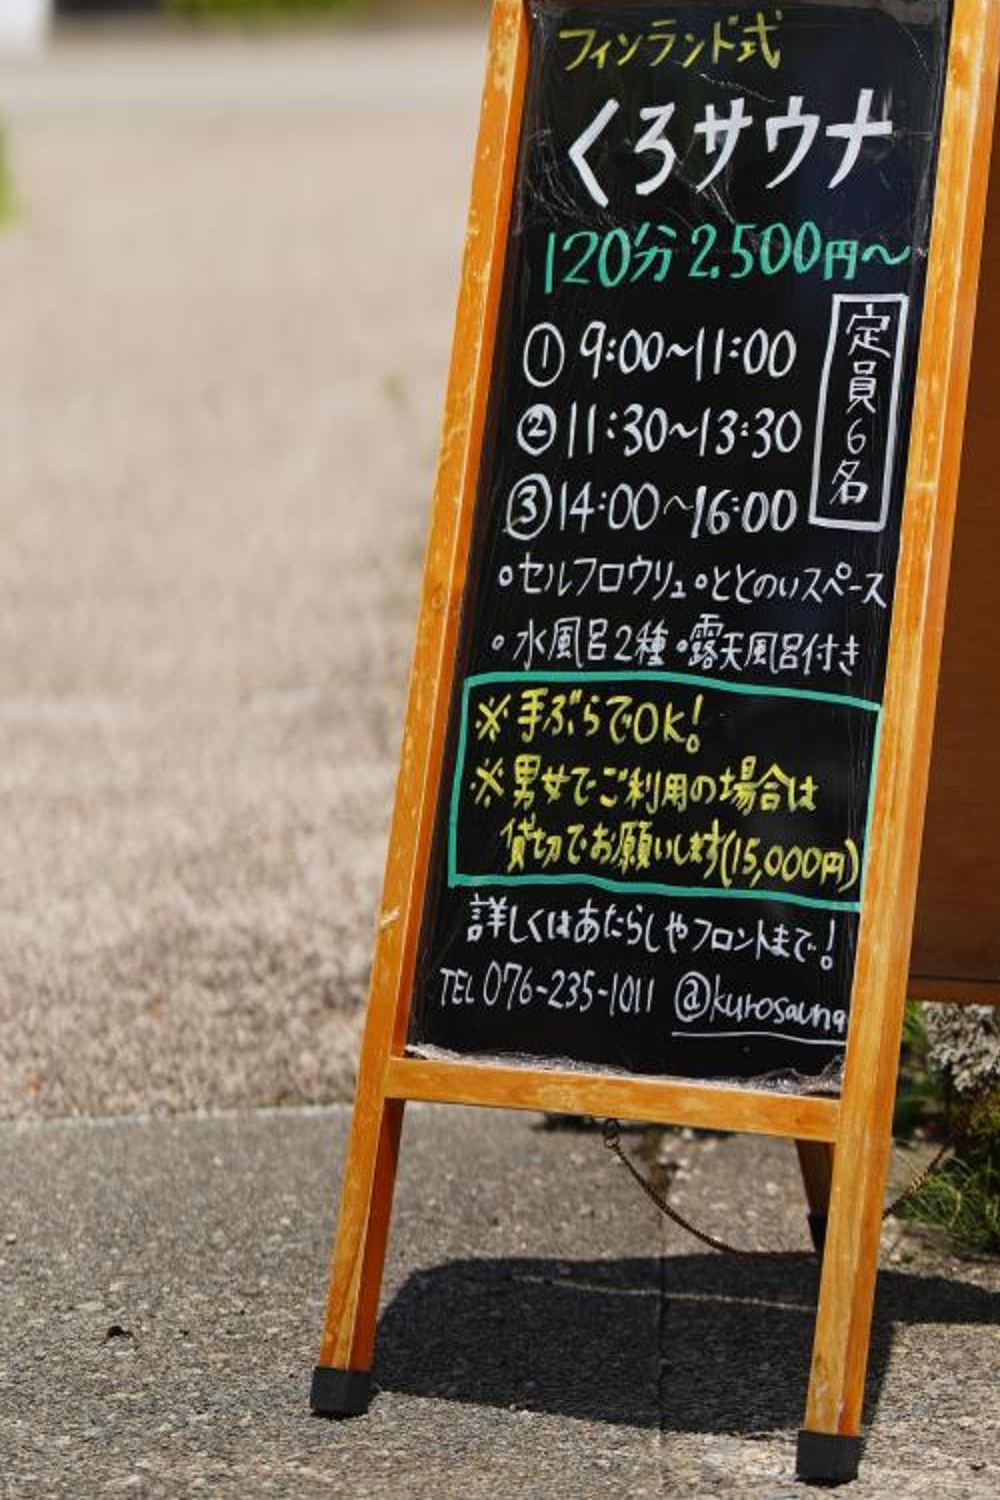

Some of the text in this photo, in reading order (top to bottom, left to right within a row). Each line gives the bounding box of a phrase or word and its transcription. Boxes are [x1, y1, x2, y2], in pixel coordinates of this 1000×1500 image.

[559, 9, 783, 71] フィンランド式
[568, 89, 893, 208] くろサウナ
[829, 304, 892, 505] 定員6名
[439, 960, 847, 1033] TEL 076-235-1011 @kurosauna
